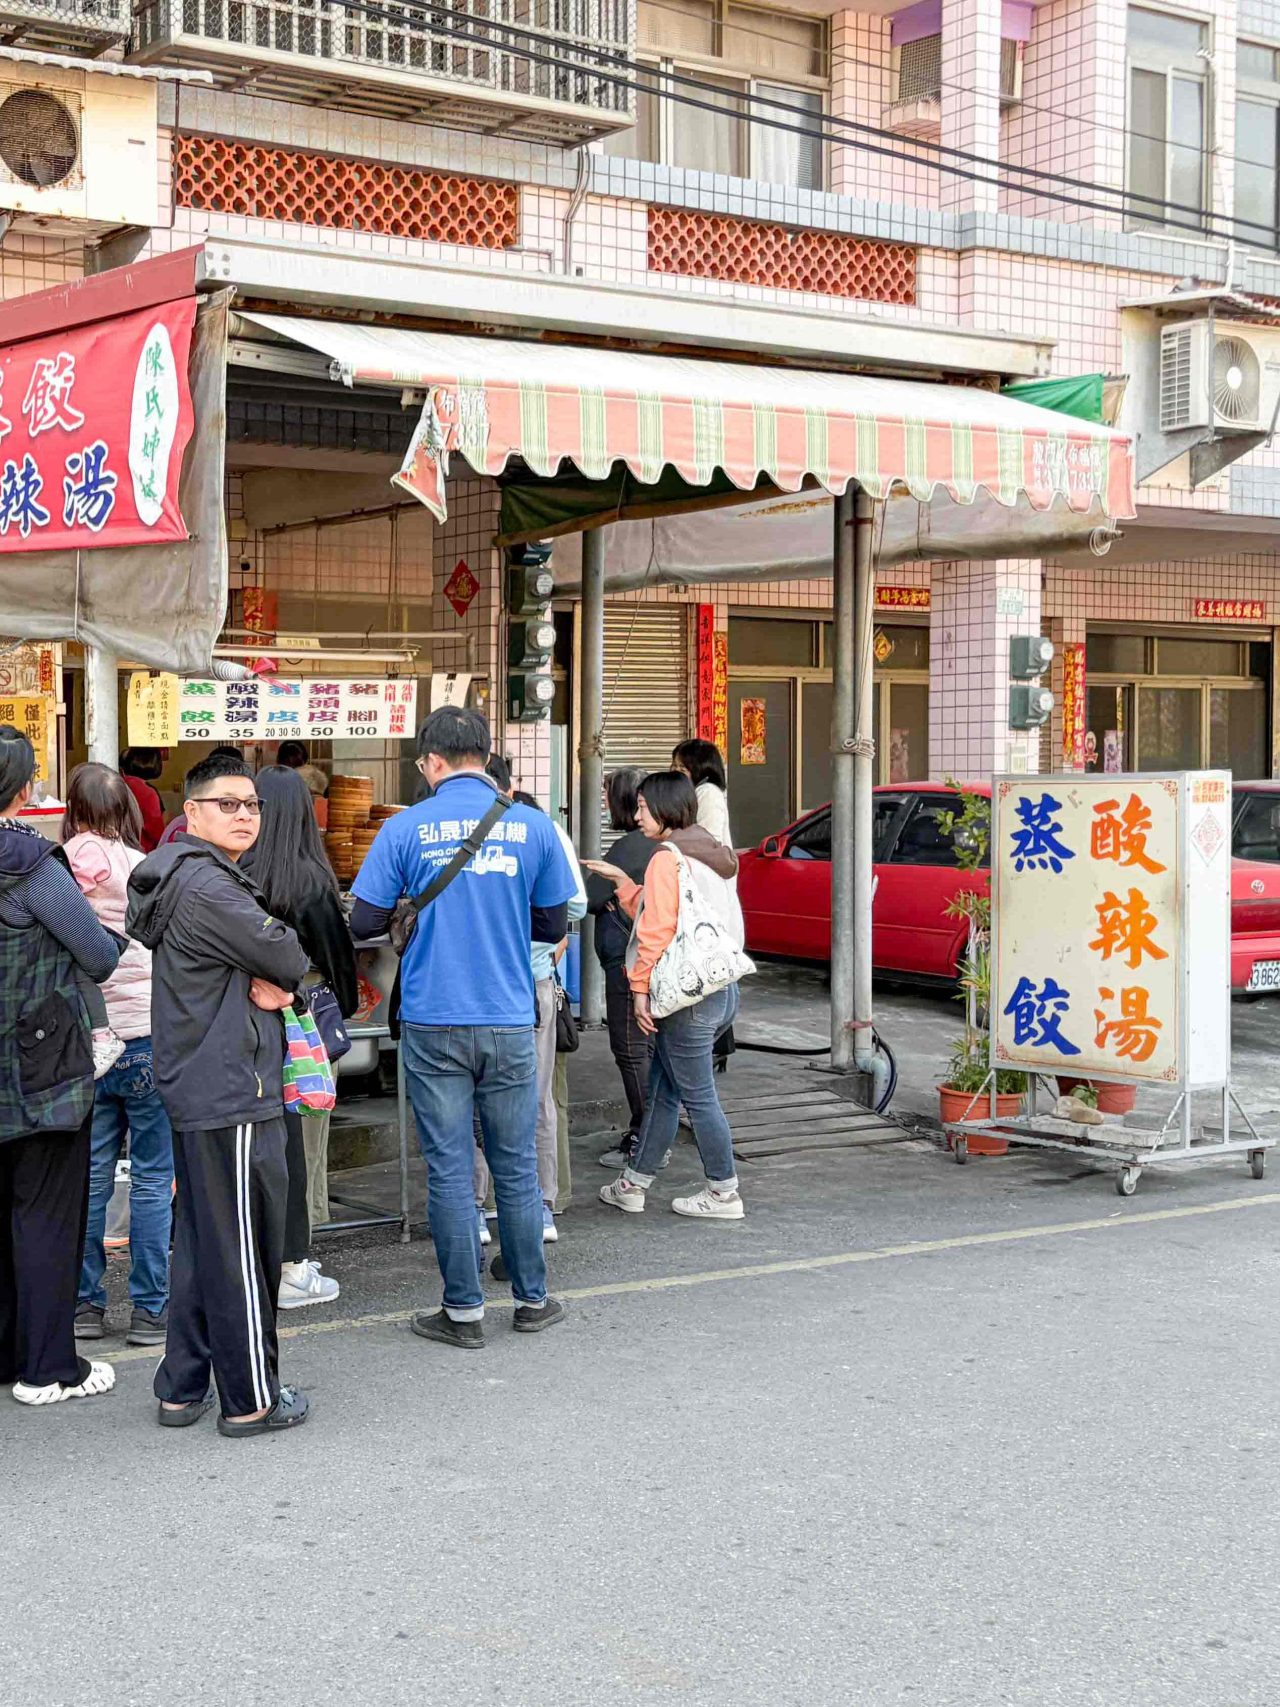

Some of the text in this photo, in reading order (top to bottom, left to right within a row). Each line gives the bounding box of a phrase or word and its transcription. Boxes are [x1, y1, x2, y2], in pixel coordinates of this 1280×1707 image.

[140, 340, 166, 500] 陳氏姊妹
[181, 683, 216, 723] 蒸餃
[224, 683, 259, 723] 酸辣湯
[267, 684, 300, 723] 豬皮
[307, 684, 340, 723] 豬頭皮
[347, 684, 379, 722] 豬腳
[184, 728, 210, 738] 50
[228, 728, 255, 738] 35
[265, 727, 301, 737] 20 30 50
[310, 727, 334, 737] 50
[346, 726, 377, 736] 100
[421, 850, 444, 860] HONG
[1003, 792, 1082, 1056] 蒸餃
[1088, 792, 1170, 1063] 酸辣湯
